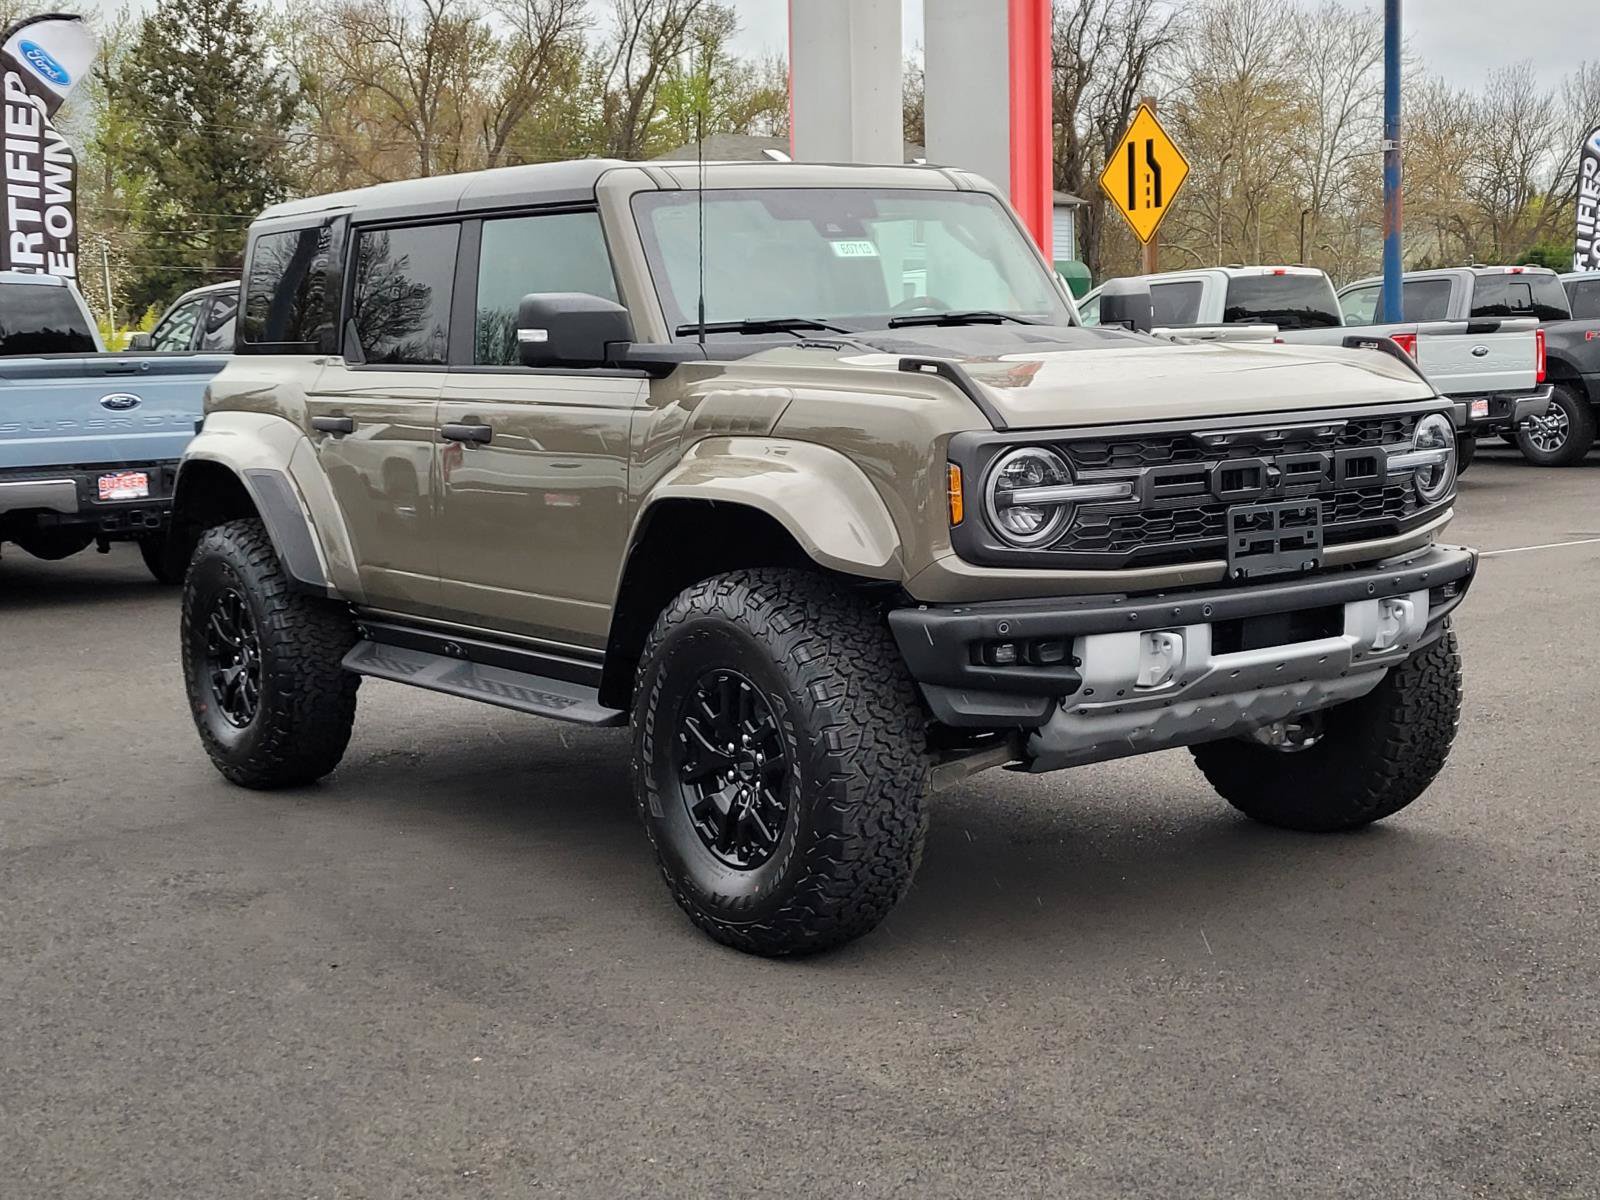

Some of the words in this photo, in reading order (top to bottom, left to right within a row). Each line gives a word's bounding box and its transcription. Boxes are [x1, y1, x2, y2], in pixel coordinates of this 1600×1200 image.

[26, 47, 60, 81] Ford
[5, 71, 44, 272] RTIFIED
[1140, 446, 1387, 509] FORD
